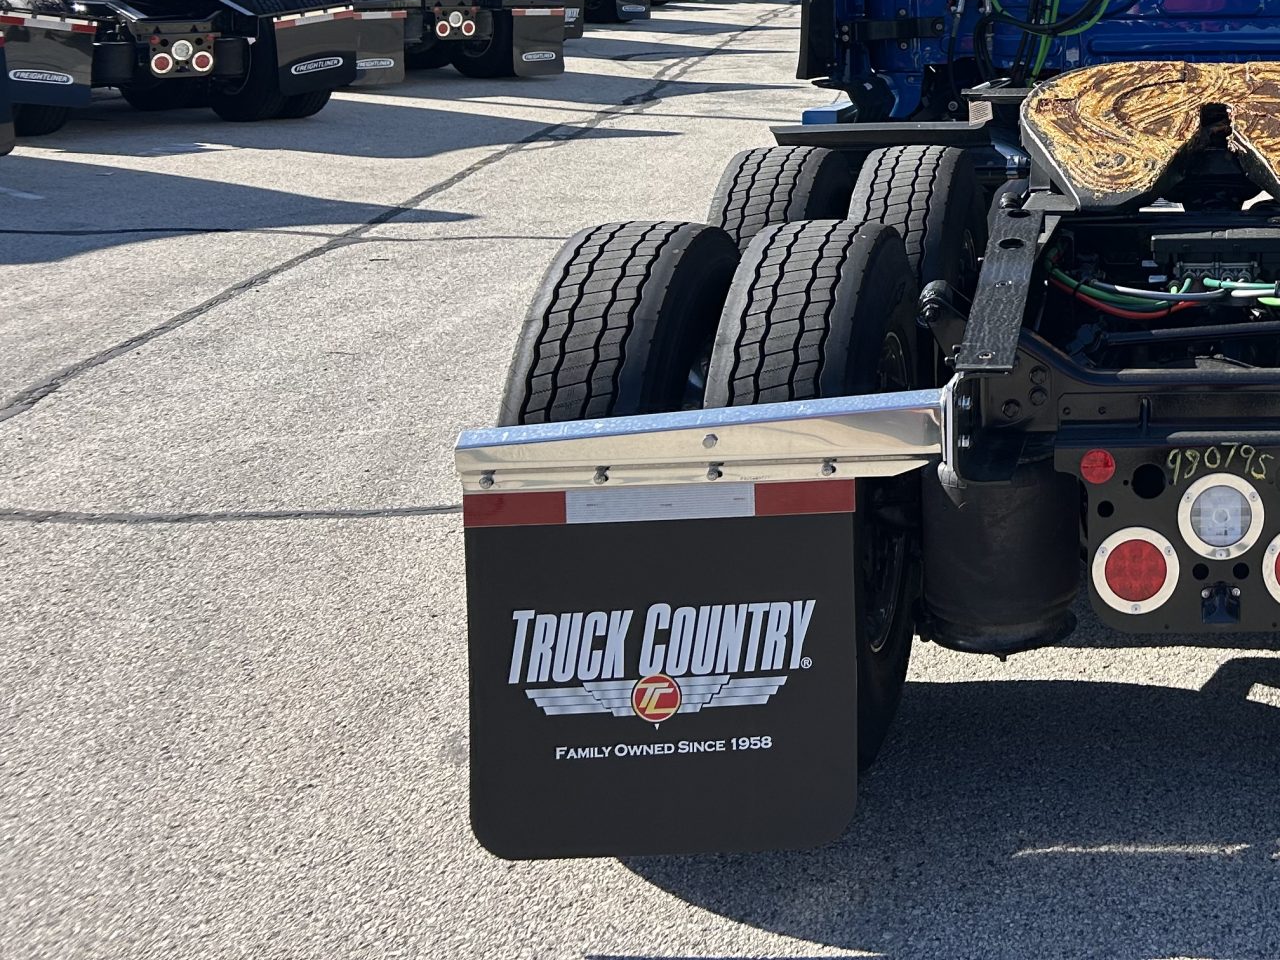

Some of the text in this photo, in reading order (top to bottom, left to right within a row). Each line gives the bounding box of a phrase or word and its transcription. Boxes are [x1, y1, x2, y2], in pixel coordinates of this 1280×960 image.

[296, 59, 338, 72] FREIGHTLINER
[15, 71, 68, 82] FREIGHTLINER
[508, 599, 816, 684] TRUCK COUNTRY
[555, 735, 773, 760] FAMILY OWNED SINCE 1958
